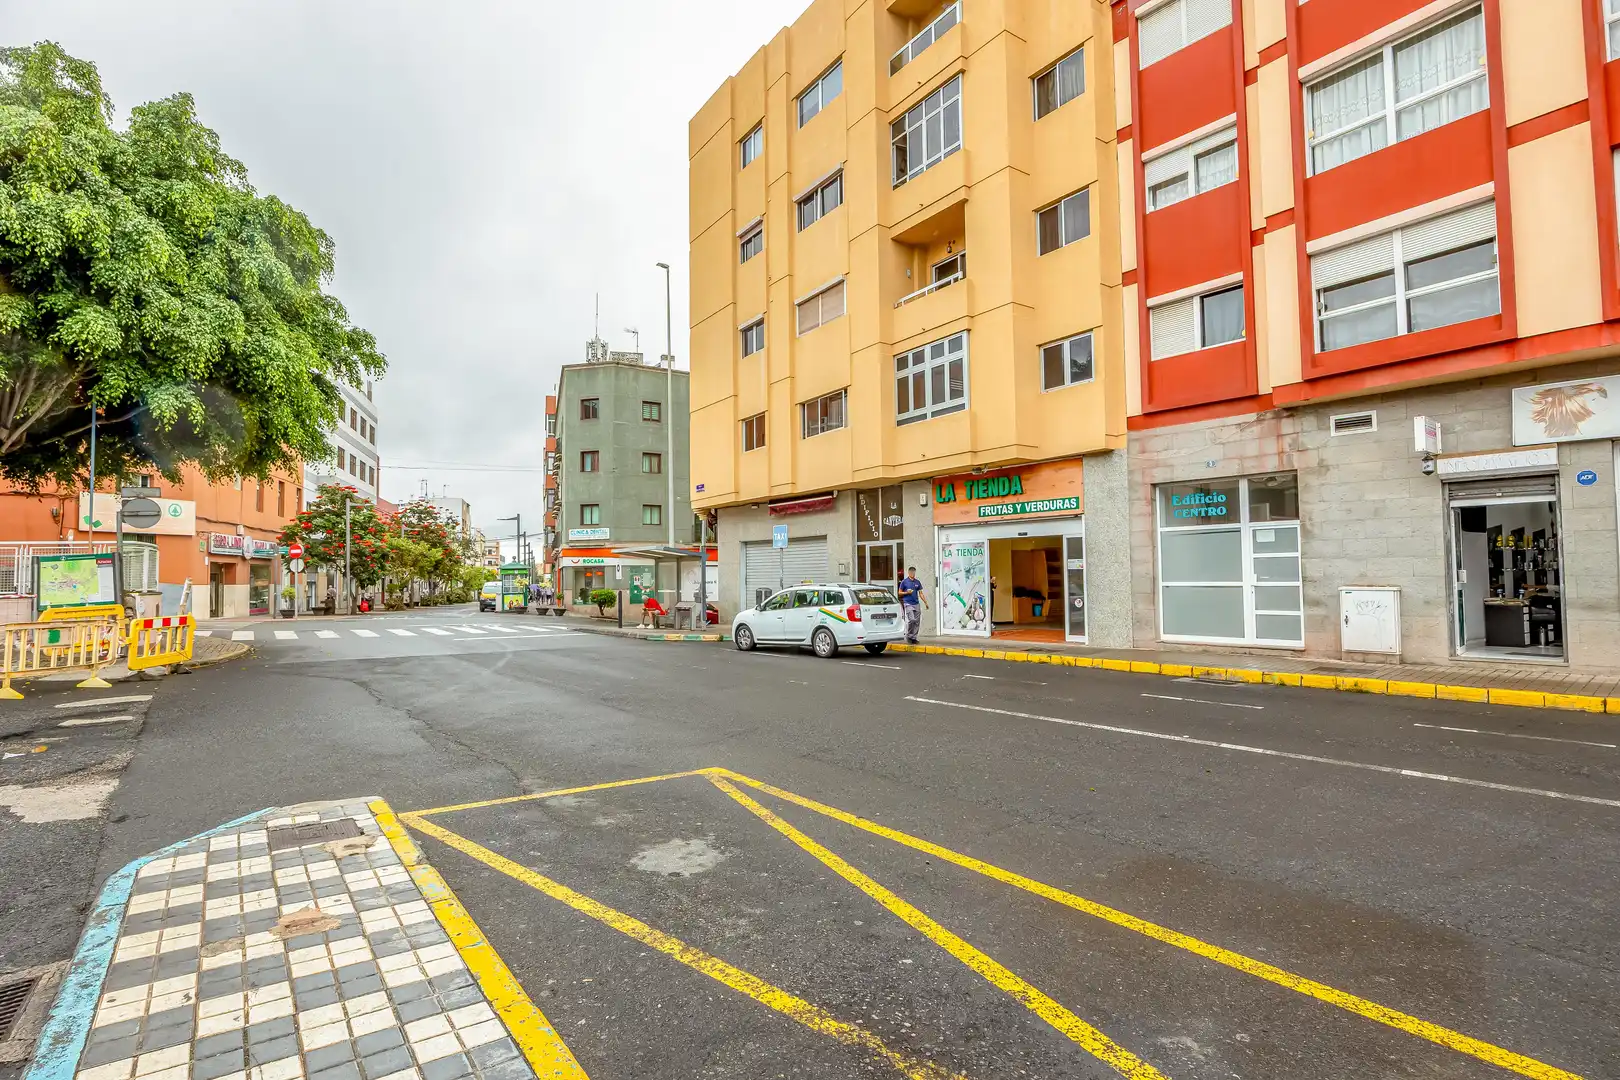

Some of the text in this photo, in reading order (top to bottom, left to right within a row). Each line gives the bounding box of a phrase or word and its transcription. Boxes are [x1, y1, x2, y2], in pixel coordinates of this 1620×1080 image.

[936, 475, 1023, 503] LA TIENDA
[1172, 491, 1227, 506] Edificio
[980, 498, 1077, 516] FRUTAS Y VERDURAS
[1173, 506, 1227, 518] CENTRO
[860, 494, 878, 537] EDIFICIO
[943, 548, 984, 557] LA TIENDA
